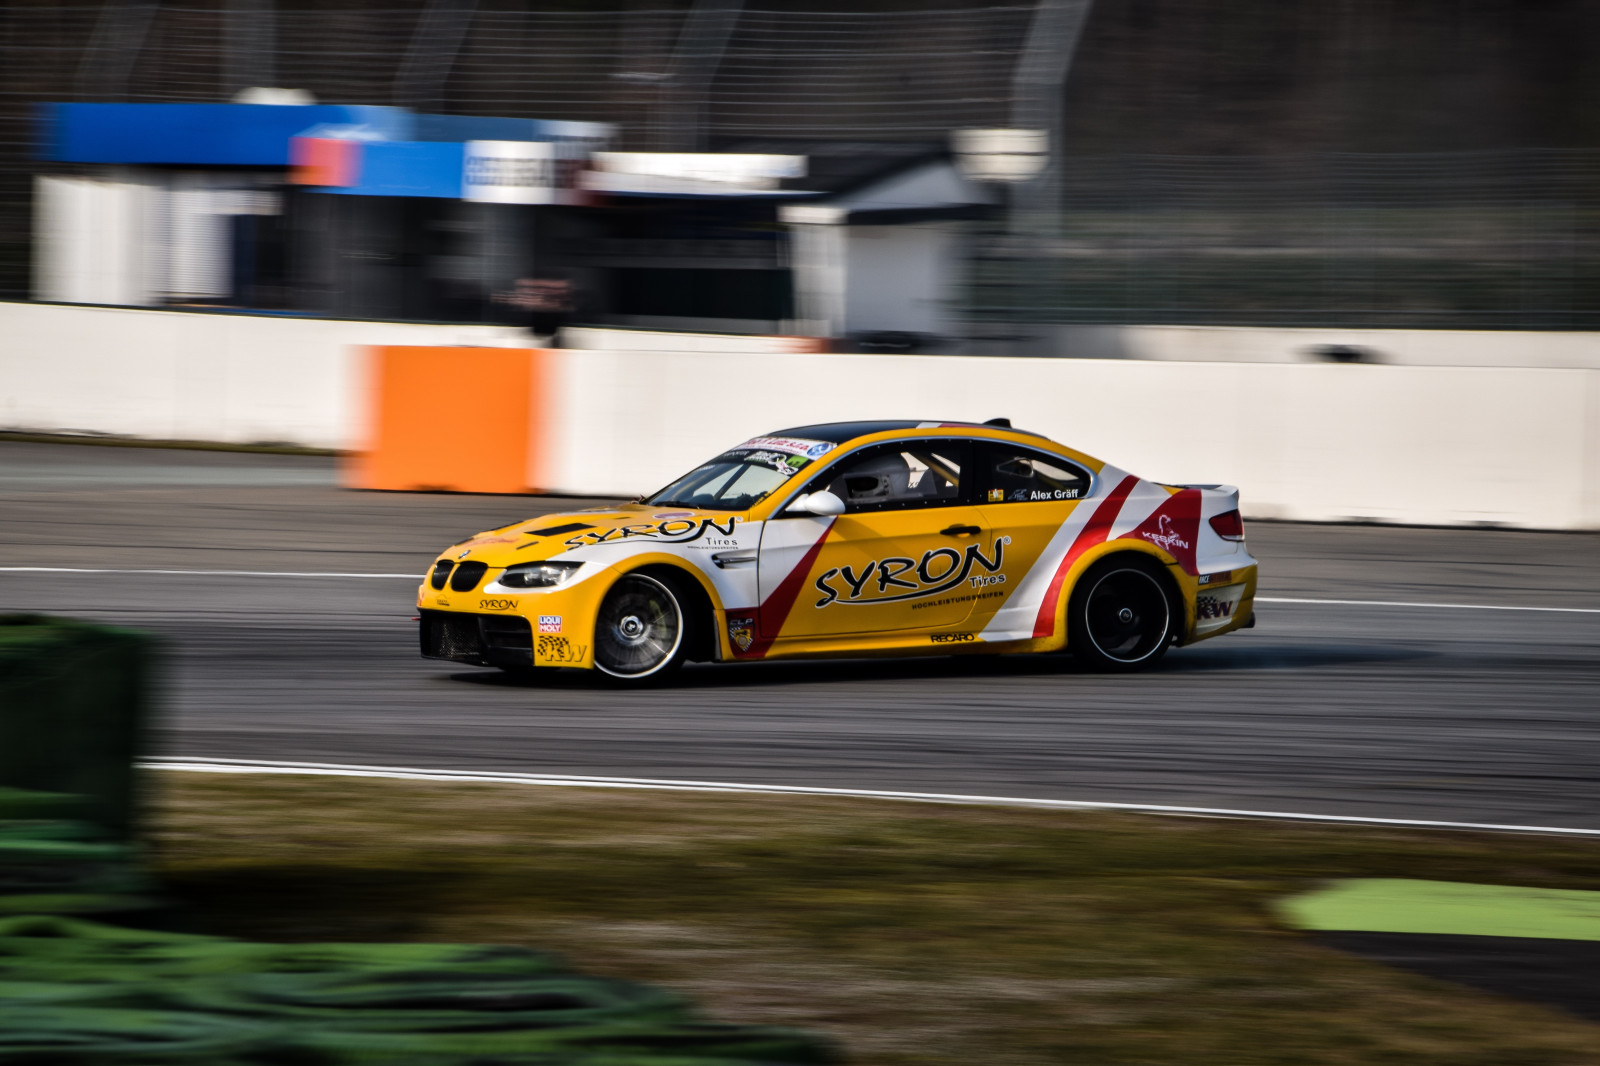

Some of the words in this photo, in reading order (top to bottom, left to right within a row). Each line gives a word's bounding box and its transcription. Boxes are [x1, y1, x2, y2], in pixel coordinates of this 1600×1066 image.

[1030, 490, 1052, 500] Alex
[1054, 488, 1079, 499] Gräff
[705, 536, 738, 546] Tires
[1142, 531, 1189, 550] KESKIN
[969, 573, 1006, 589] Tires
[479, 599, 519, 611] SYRON
[911, 590, 1005, 610] HOCHLEISTUNGSREIFEN
[1197, 604, 1233, 621] KW
[539, 616, 562, 625] LIQUI
[539, 624, 562, 633] MOLY
[930, 632, 975, 643] RECARO
[545, 645, 587, 662] KW
